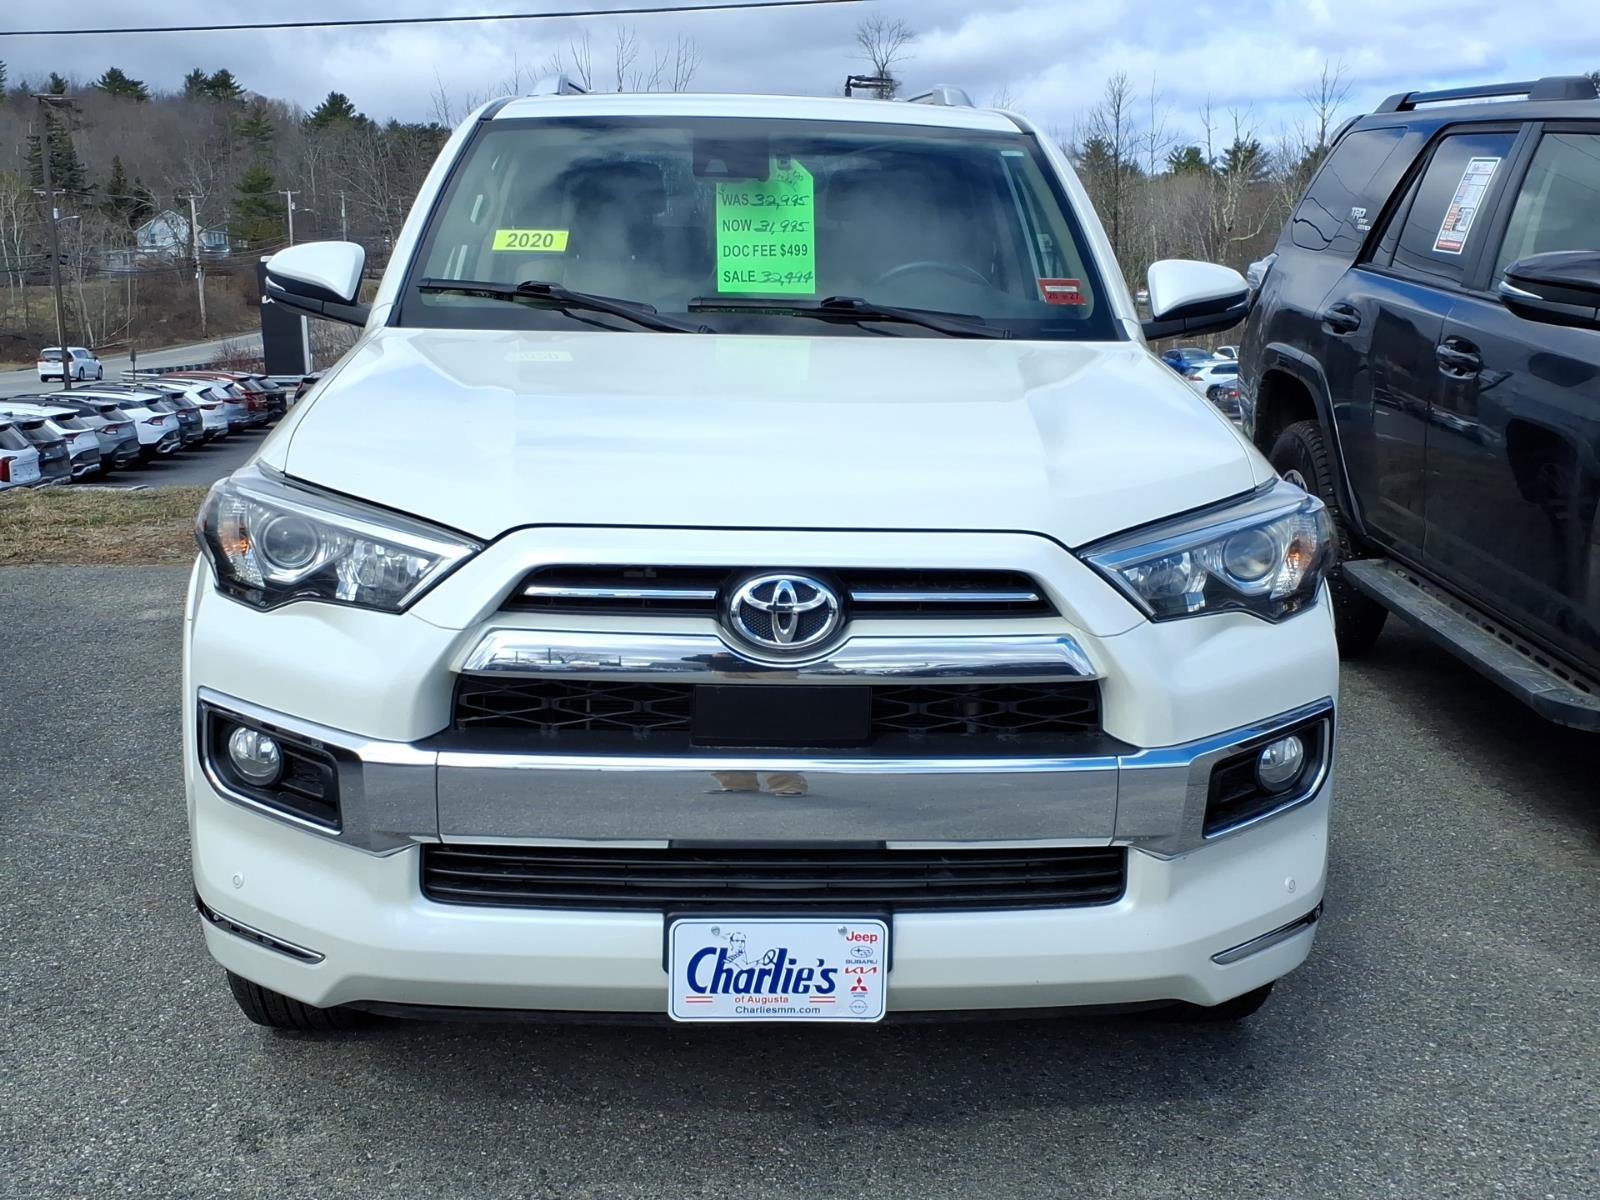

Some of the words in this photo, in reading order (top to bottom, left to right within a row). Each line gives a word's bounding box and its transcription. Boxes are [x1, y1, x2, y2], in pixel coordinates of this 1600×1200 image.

[721, 193, 749, 206] WAS
[722, 219, 752, 232] NOW
[505, 232, 554, 248] 2020
[723, 244, 750, 257] DOC
[752, 244, 777, 257] FEE
[779, 243, 808, 258] $499
[723, 270, 756, 283] SALE
[845, 931, 878, 944] Jeep
[686, 946, 838, 995] Charlie's
[844, 966, 878, 975] KIA
[734, 995, 745, 1004] of
[747, 995, 790, 1006] Augusta
[735, 1005, 821, 1015] Charliesmm.com
